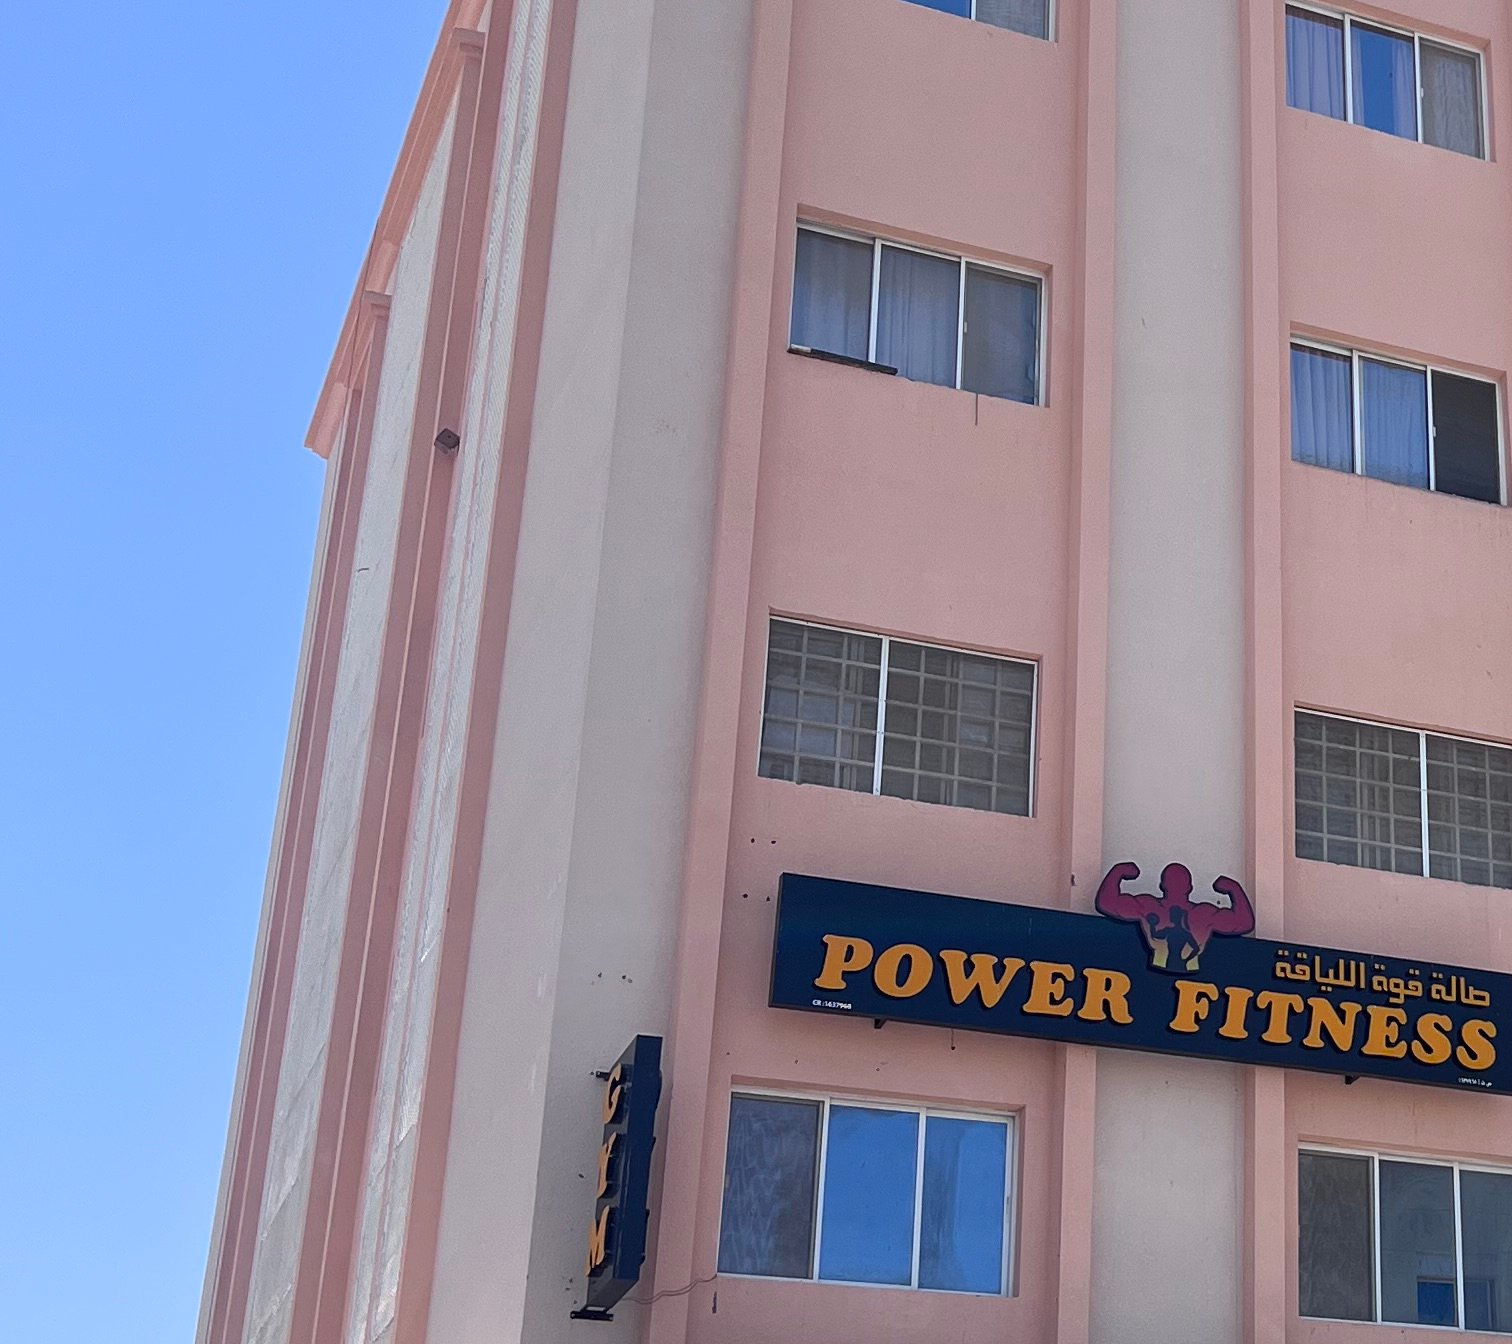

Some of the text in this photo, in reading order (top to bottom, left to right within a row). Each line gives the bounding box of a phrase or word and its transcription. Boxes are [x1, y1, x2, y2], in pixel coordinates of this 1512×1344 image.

[814, 933, 1497, 1071] POWER FITNESS
[1275, 949, 1490, 1007] صالة قوة اللياقة
